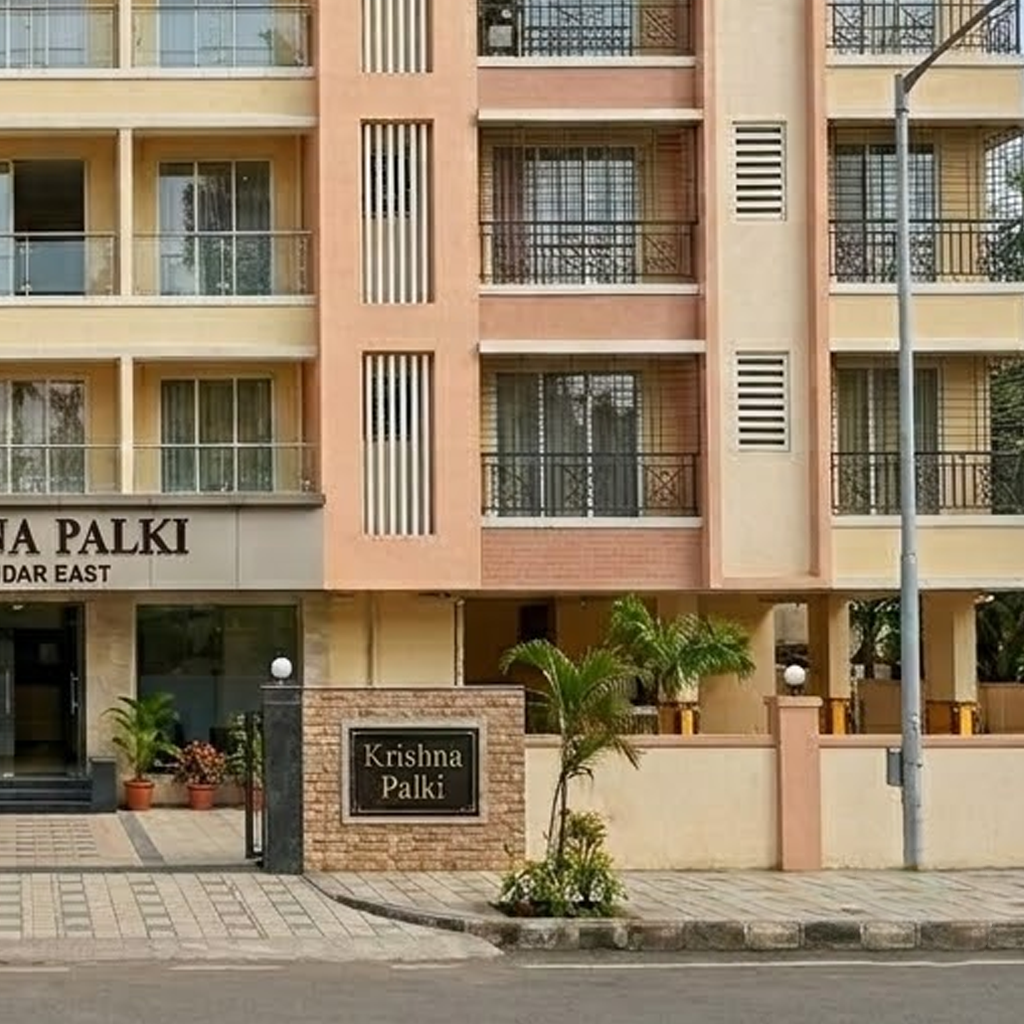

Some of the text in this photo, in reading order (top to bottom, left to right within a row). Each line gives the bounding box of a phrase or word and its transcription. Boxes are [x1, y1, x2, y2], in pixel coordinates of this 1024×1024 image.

[55, 518, 190, 556] PALKI
[54, 564, 111, 583] EAST
[363, 743, 463, 768] Krishna
[381, 774, 445, 800] Palki
